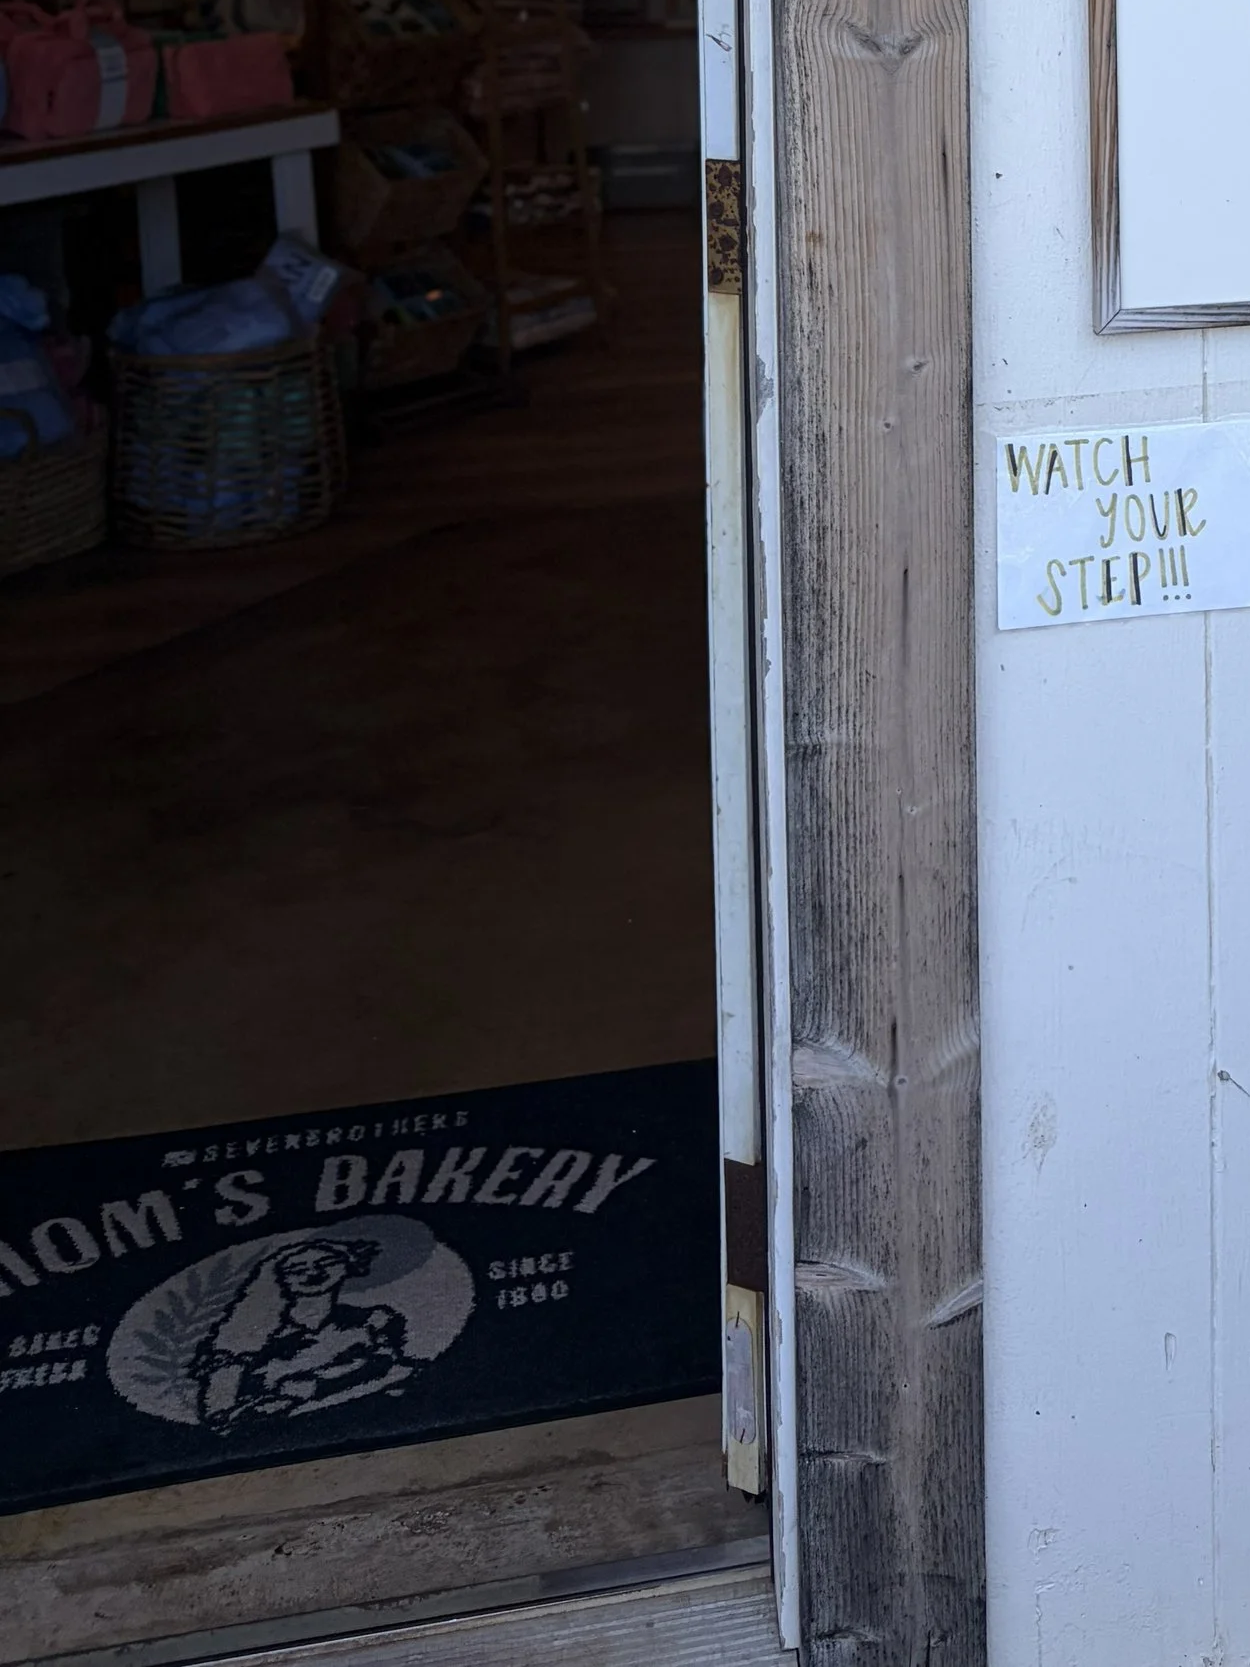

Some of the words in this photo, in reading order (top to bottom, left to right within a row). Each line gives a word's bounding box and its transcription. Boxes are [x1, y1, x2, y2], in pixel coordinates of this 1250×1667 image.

[1004, 435, 1151, 496] WATCH
[1095, 488, 1207, 548] YOUR
[1036, 545, 1192, 616] STEP!!!
[314, 1145, 657, 1214] BAKERY
